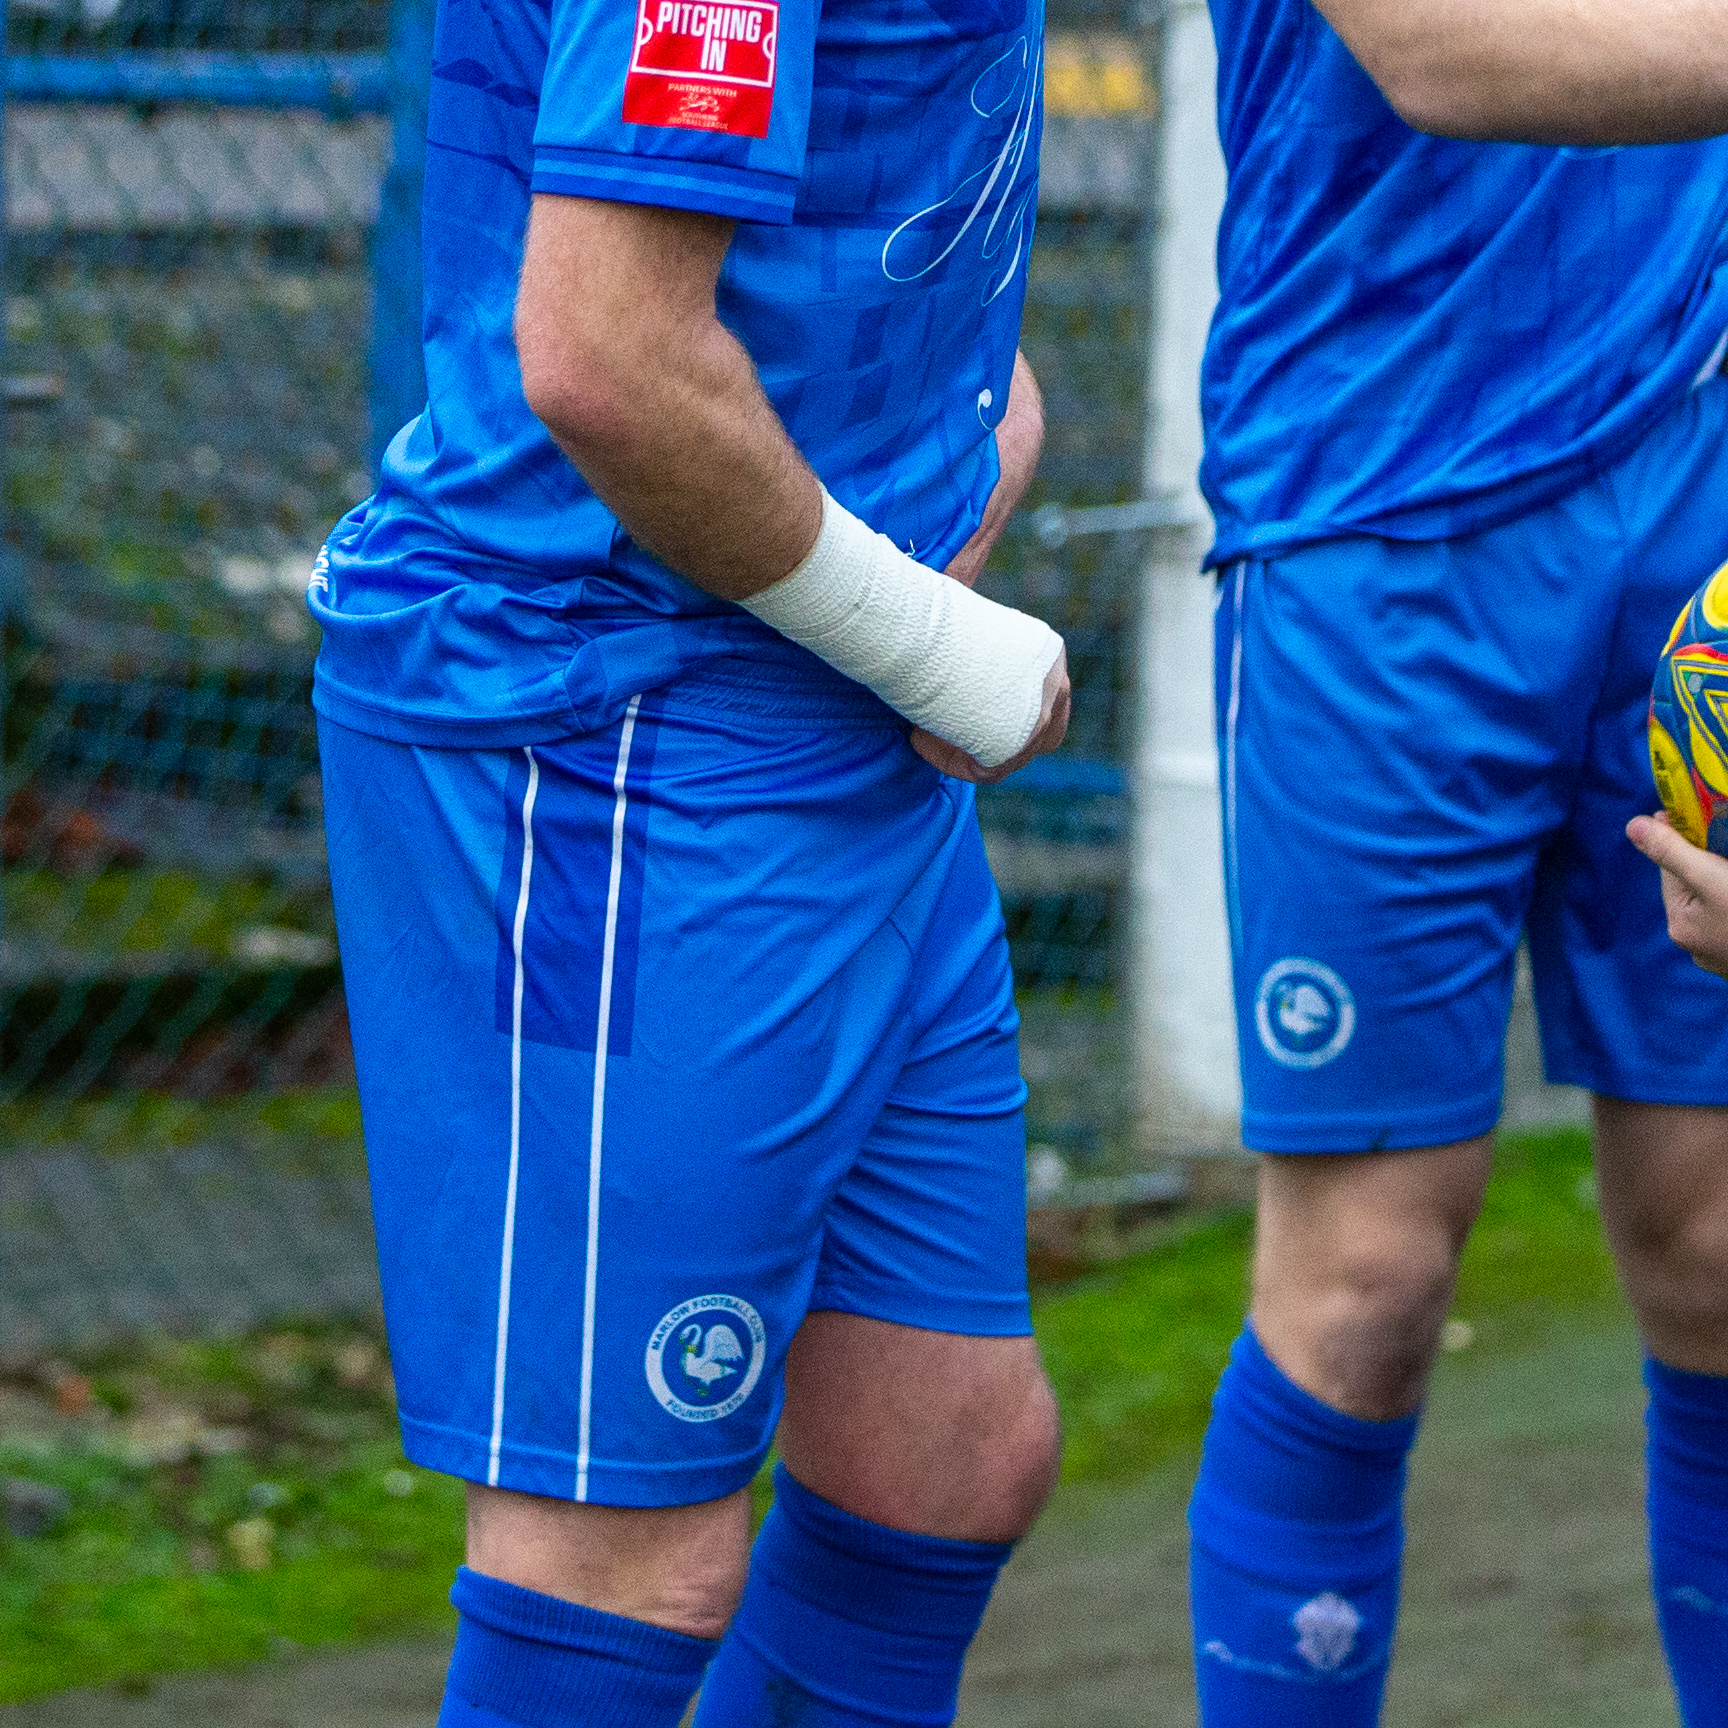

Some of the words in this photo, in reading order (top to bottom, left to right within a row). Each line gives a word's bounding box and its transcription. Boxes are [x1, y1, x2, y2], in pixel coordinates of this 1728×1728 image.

[656, 0, 763, 43] PITCHING
[700, 37, 727, 72] IN
[668, 83, 711, 94] PARTNERS
[713, 88, 738, 97] WITH
